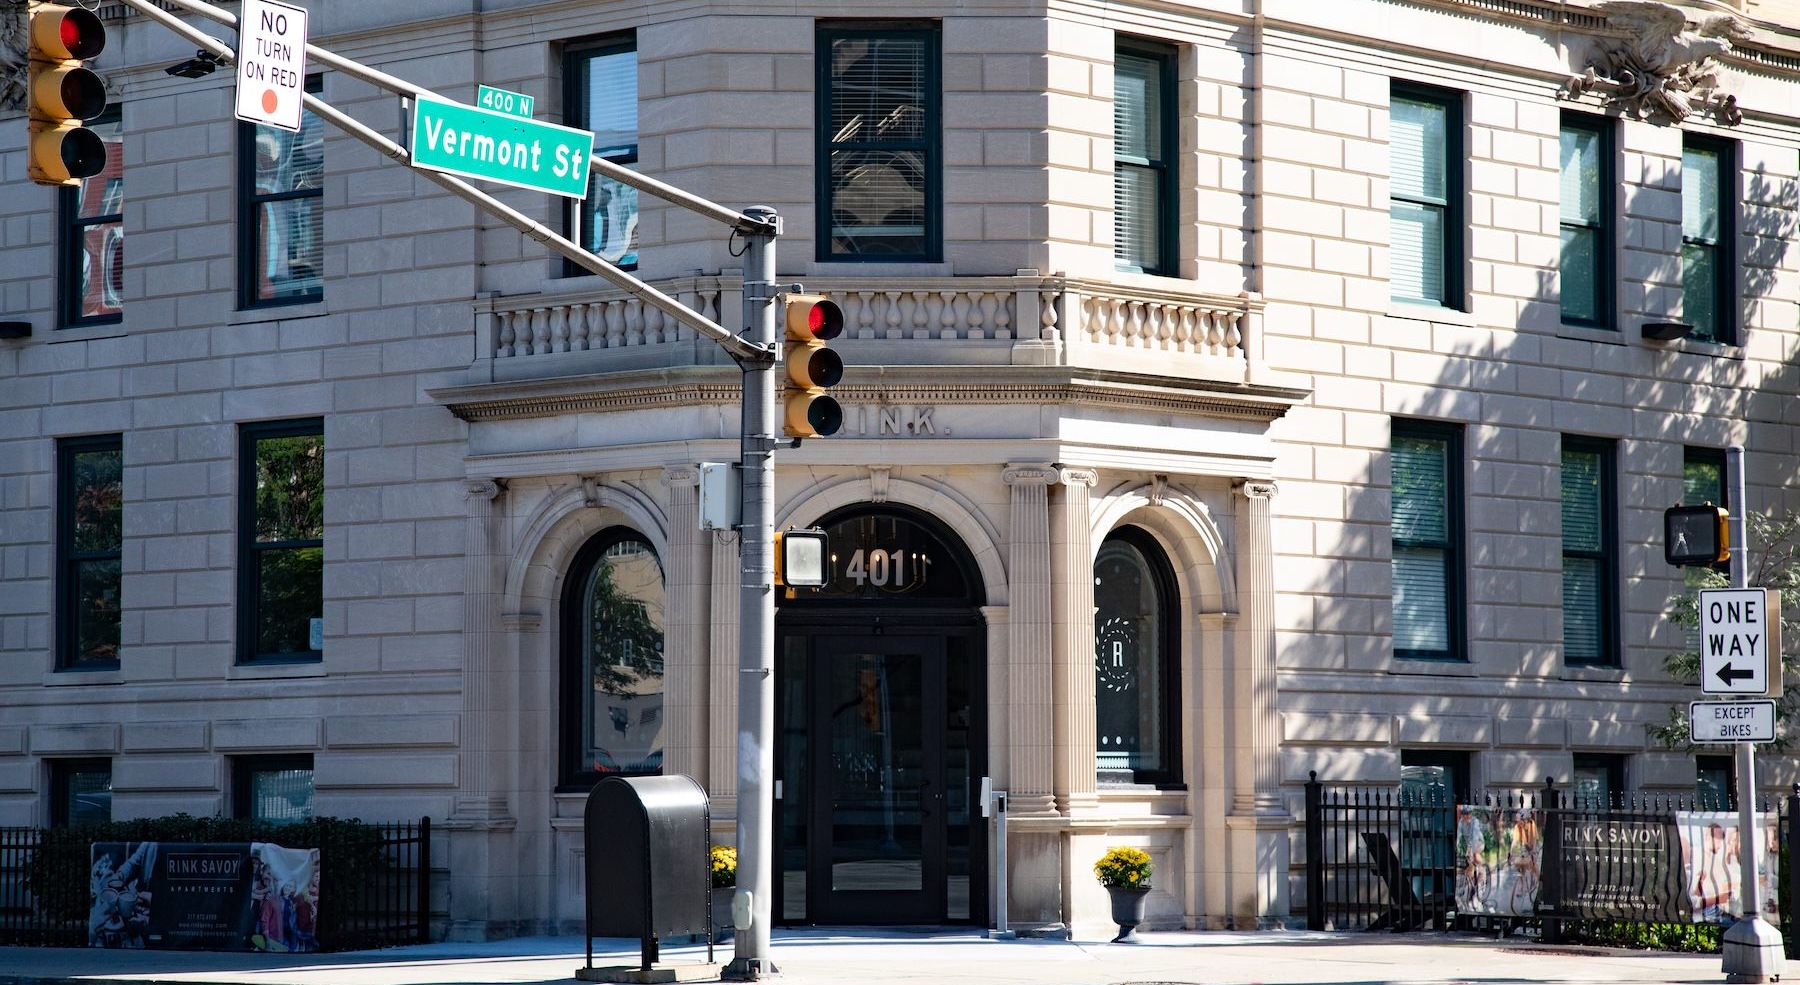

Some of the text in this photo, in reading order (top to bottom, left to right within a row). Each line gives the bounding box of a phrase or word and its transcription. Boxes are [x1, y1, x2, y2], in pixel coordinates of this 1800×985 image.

[261, 9, 287, 36] NO
[256, 37, 291, 62] TURN
[246, 61, 297, 88] ON RED
[482, 90, 529, 116] 400 N
[424, 115, 583, 181] Vermont St
[841, 407, 952, 436] INK.
[845, 548, 904, 587] 401
[1710, 601, 1757, 624] ONE
[1112, 641, 1123, 667] R
[1709, 634, 1760, 657] WAY
[1714, 707, 1755, 719] EXCEPT
[1720, 724, 1752, 737] BIKES
[1564, 827, 1661, 844] RINK SAVOY
[168, 860, 239, 873] RINK SAVOY
[1566, 855, 1656, 864] APARTMENTS
